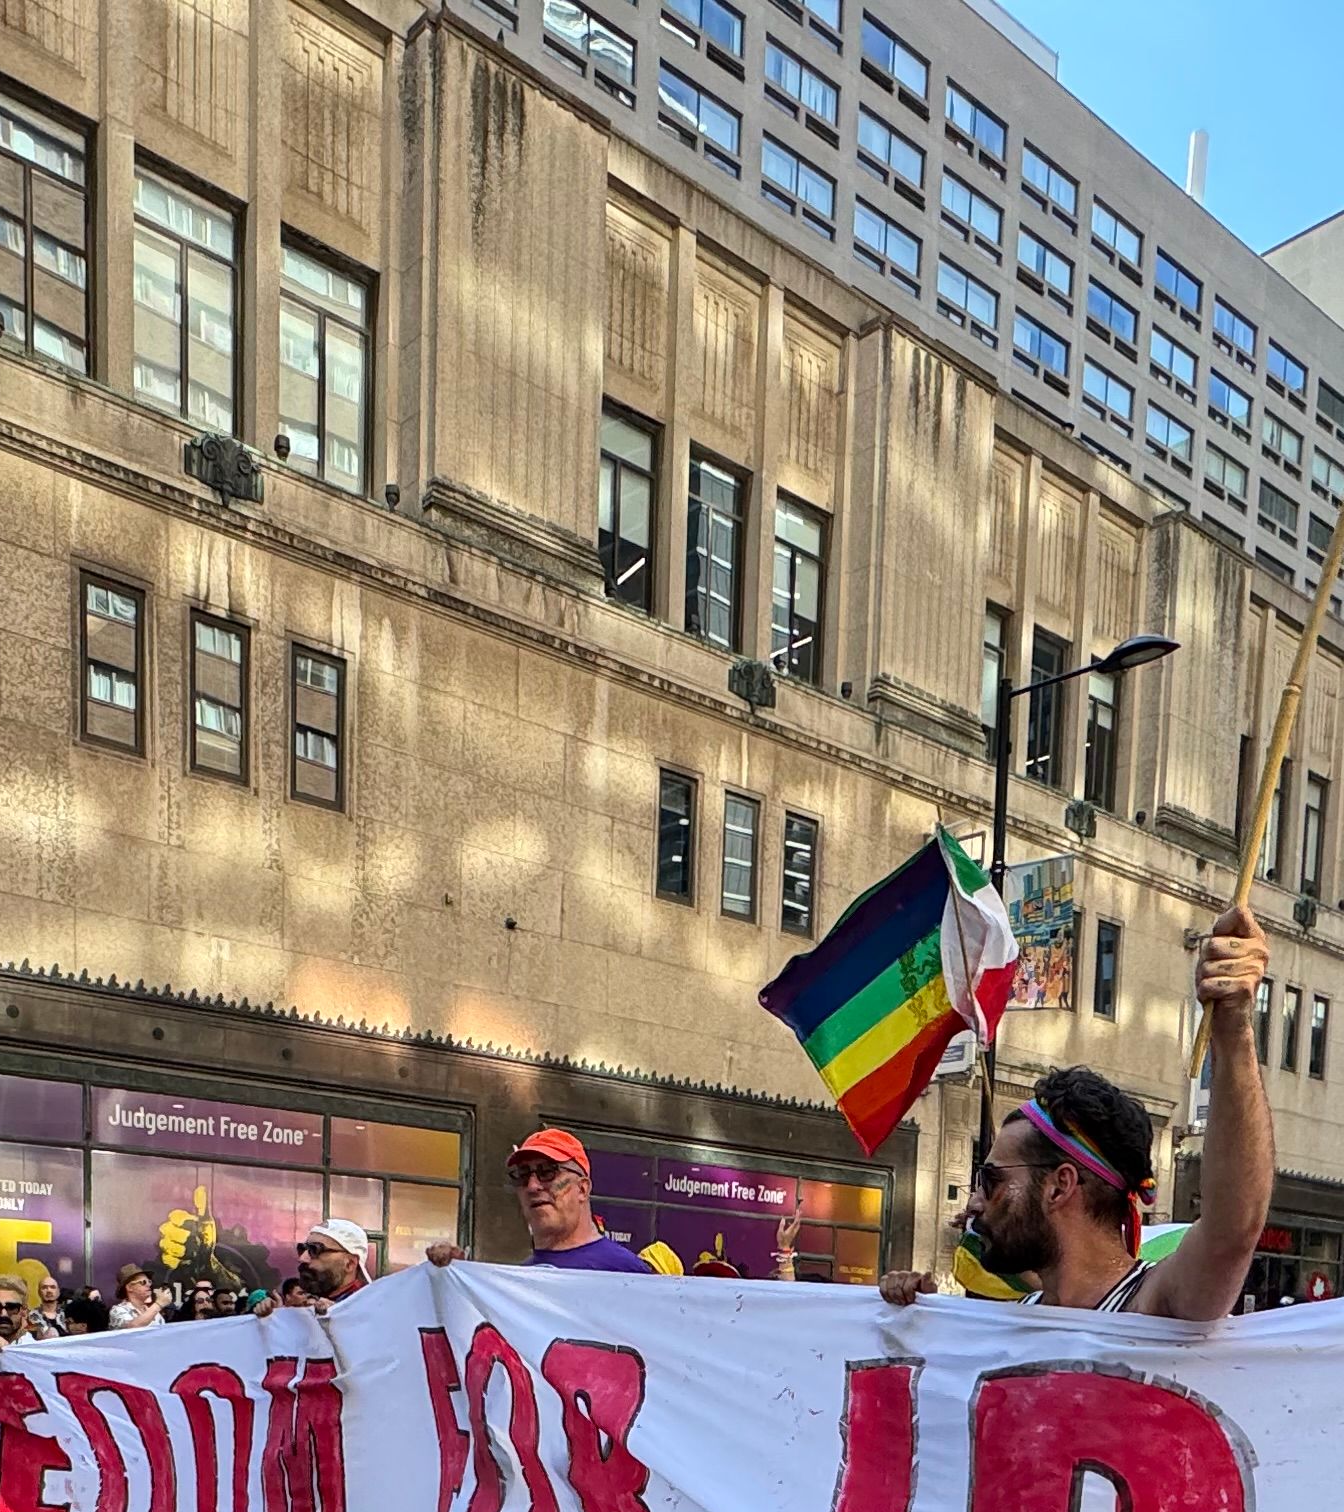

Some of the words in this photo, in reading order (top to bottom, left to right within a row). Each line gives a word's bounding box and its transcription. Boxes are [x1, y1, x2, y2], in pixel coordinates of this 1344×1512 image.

[108, 1103, 215, 1136] Judgement
[220, 1116, 258, 1141] Free
[18, 1181, 53, 1196] TODAY
[664, 1173, 729, 1198] Judgement
[731, 1181, 755, 1201] Free
